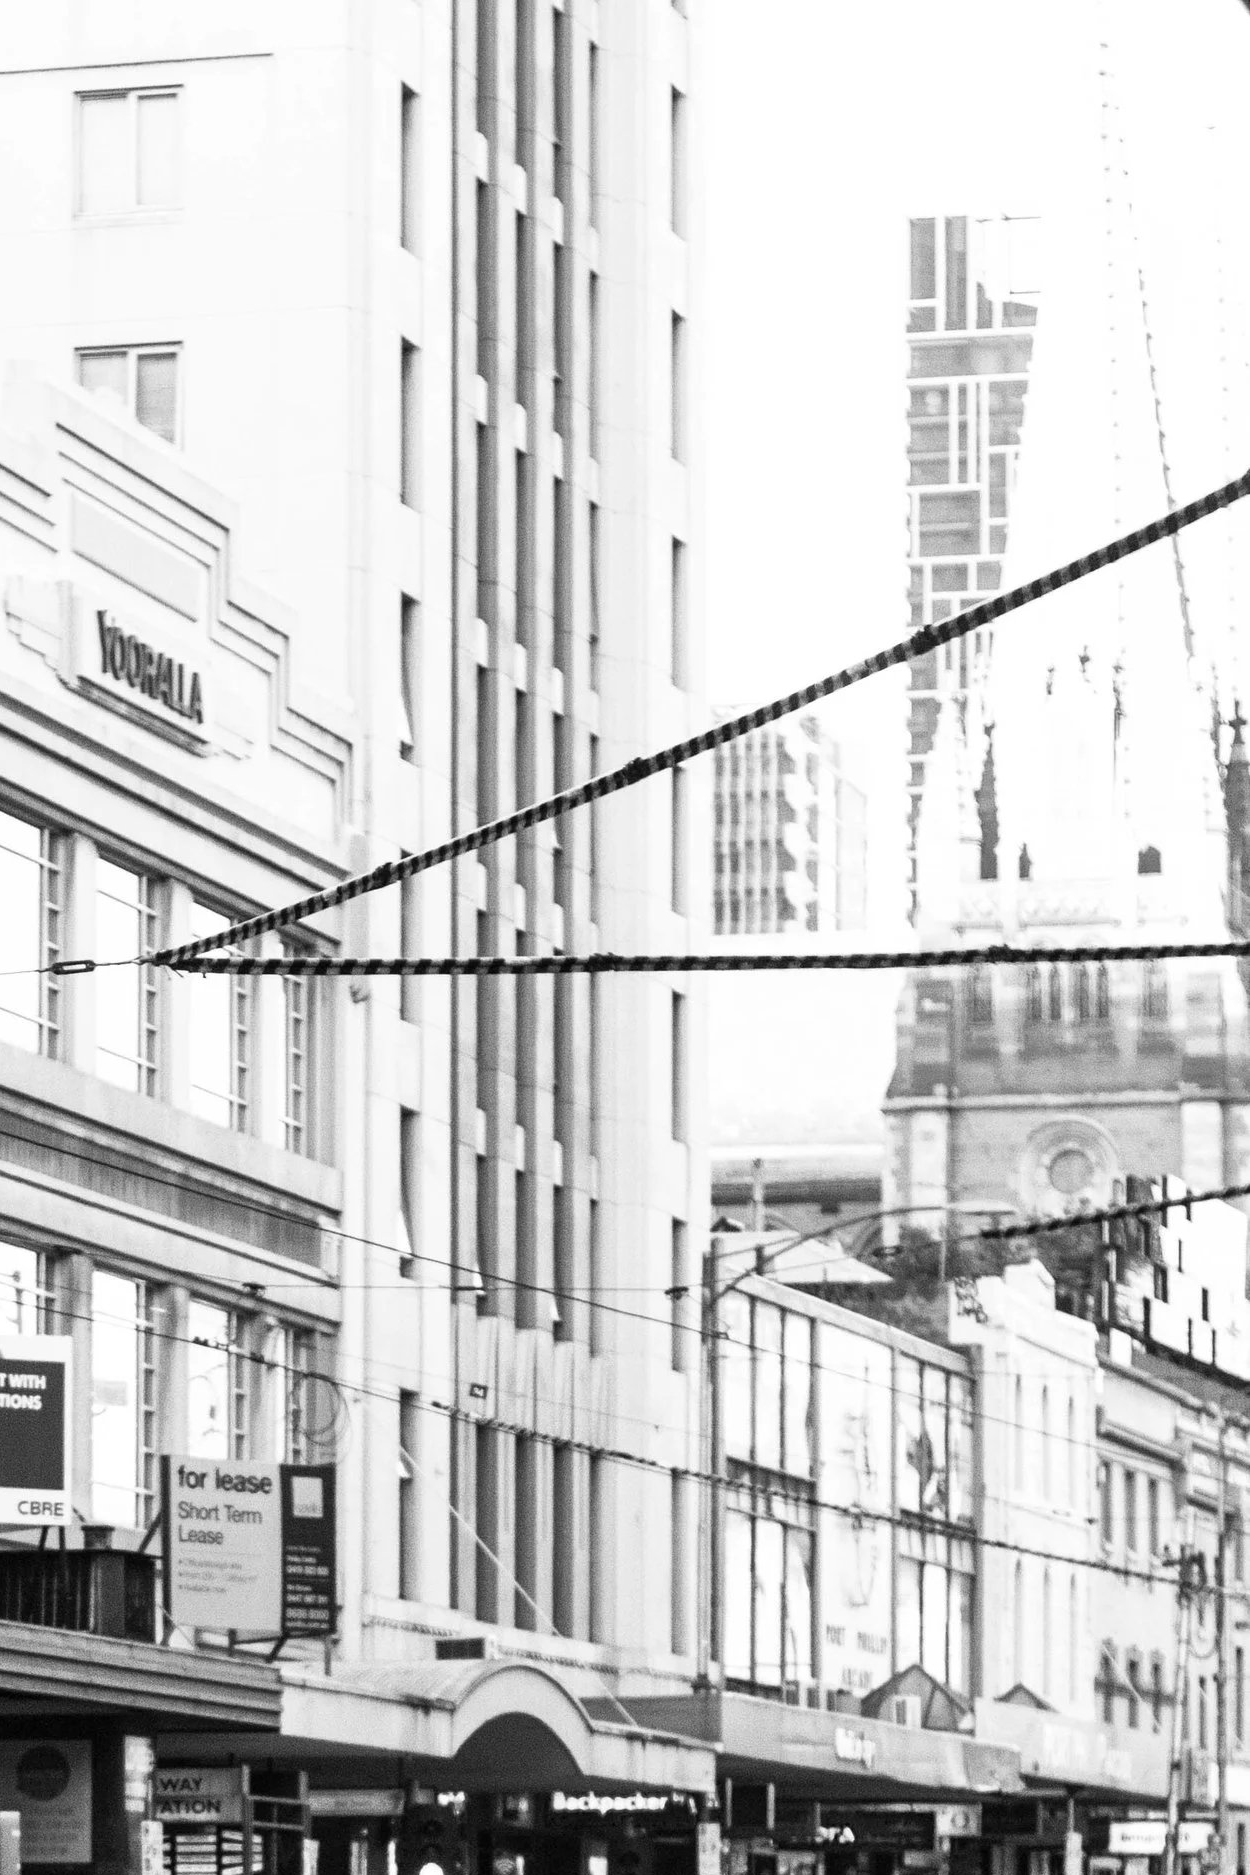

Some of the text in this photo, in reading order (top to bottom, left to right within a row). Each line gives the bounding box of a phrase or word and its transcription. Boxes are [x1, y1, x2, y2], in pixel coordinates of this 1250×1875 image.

[9, 1373, 47, 1390] WITH
[177, 1464, 273, 1495] for lease
[17, 1500, 65, 1517] CBRE
[177, 1501, 263, 1525] Short Term
[178, 1525, 224, 1545] Lease
[552, 1790, 668, 1817] Backpacker
